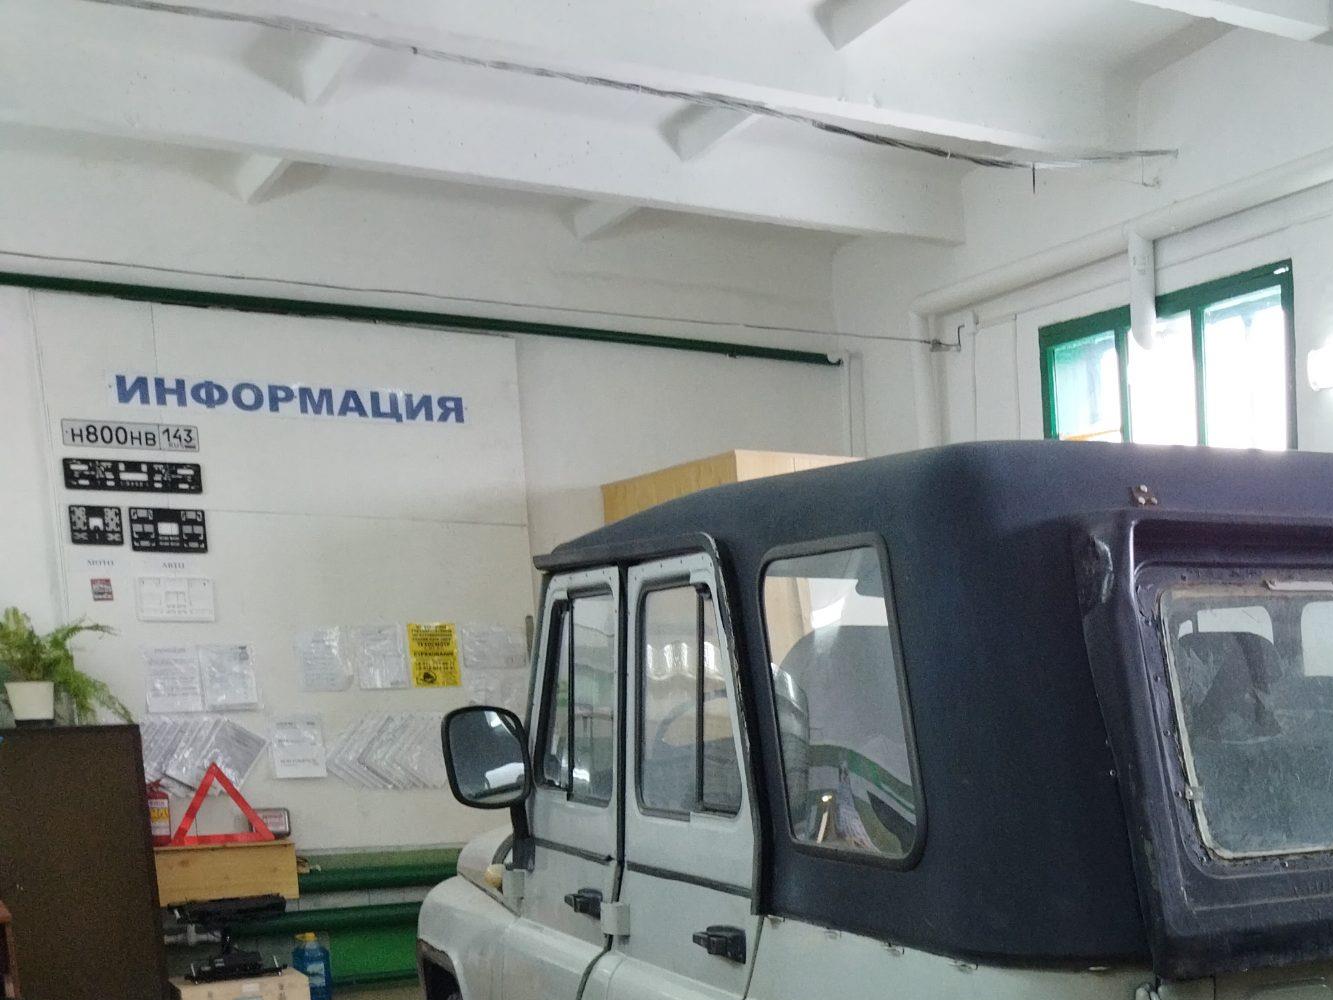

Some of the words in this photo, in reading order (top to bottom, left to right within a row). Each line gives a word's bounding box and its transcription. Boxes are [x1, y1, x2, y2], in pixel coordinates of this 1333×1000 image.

[115, 374, 465, 424] ИНФОРМАЦИЯ
[71, 425, 156, 447] Н800НВ
[162, 428, 193, 443] 143
